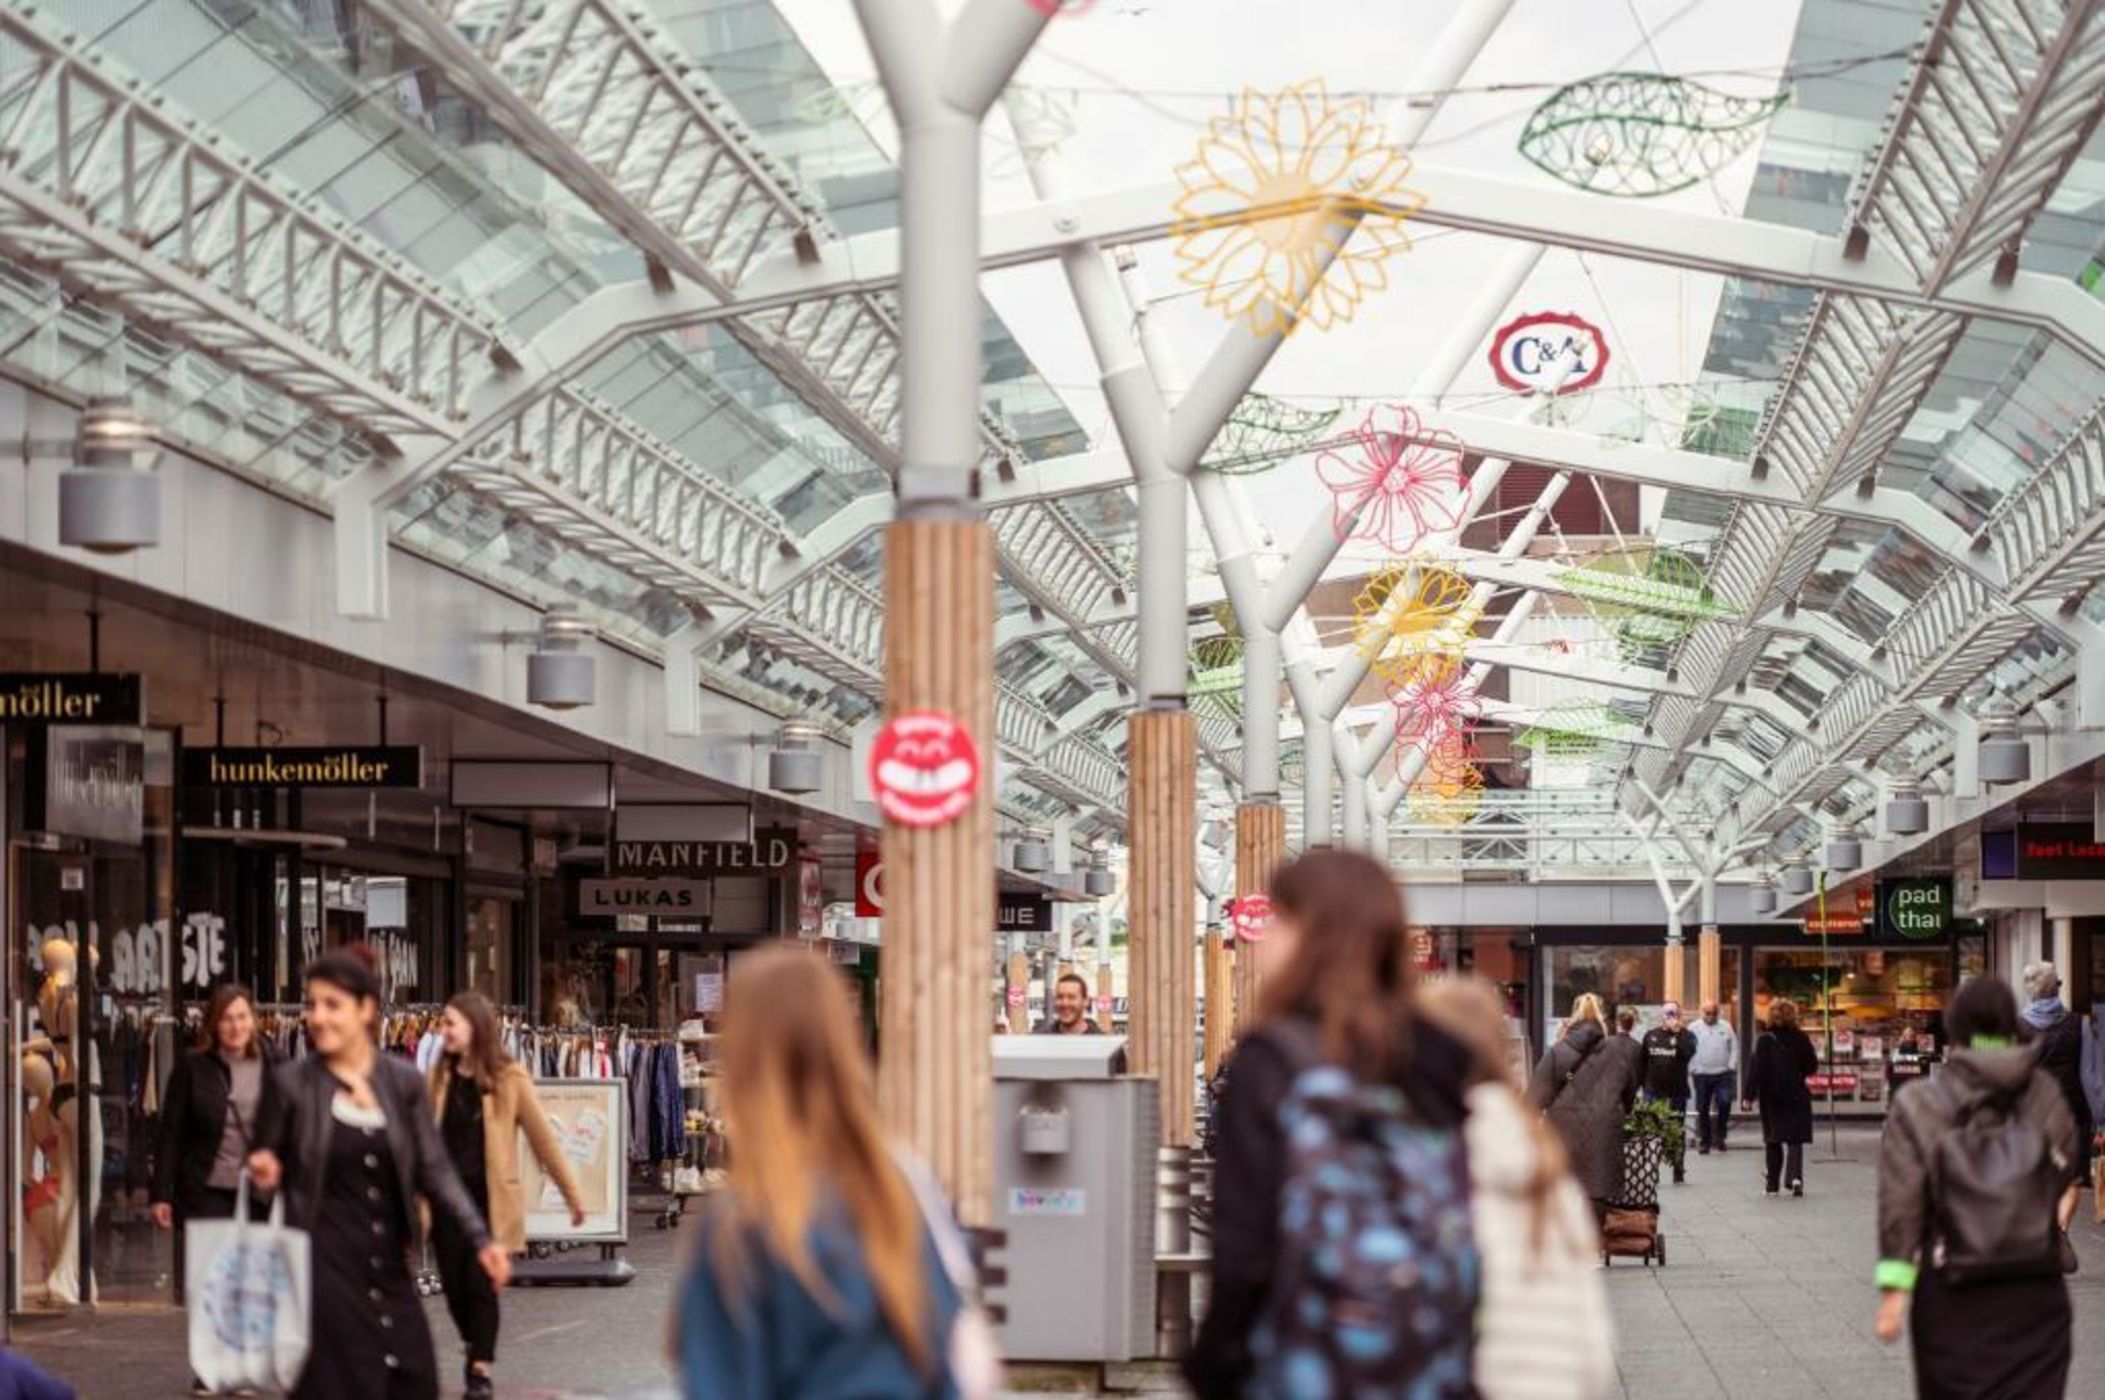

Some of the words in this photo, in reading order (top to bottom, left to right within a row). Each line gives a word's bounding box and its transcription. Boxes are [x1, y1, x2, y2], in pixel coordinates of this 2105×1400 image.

[1511, 336, 1589, 375] C&A
[211, 753, 388, 782] hunkemöller
[618, 838, 789, 867] MANFIELD
[594, 889, 692, 906] LUKAS
[1899, 884, 1940, 908] pad
[1899, 910, 1941, 929] thai
